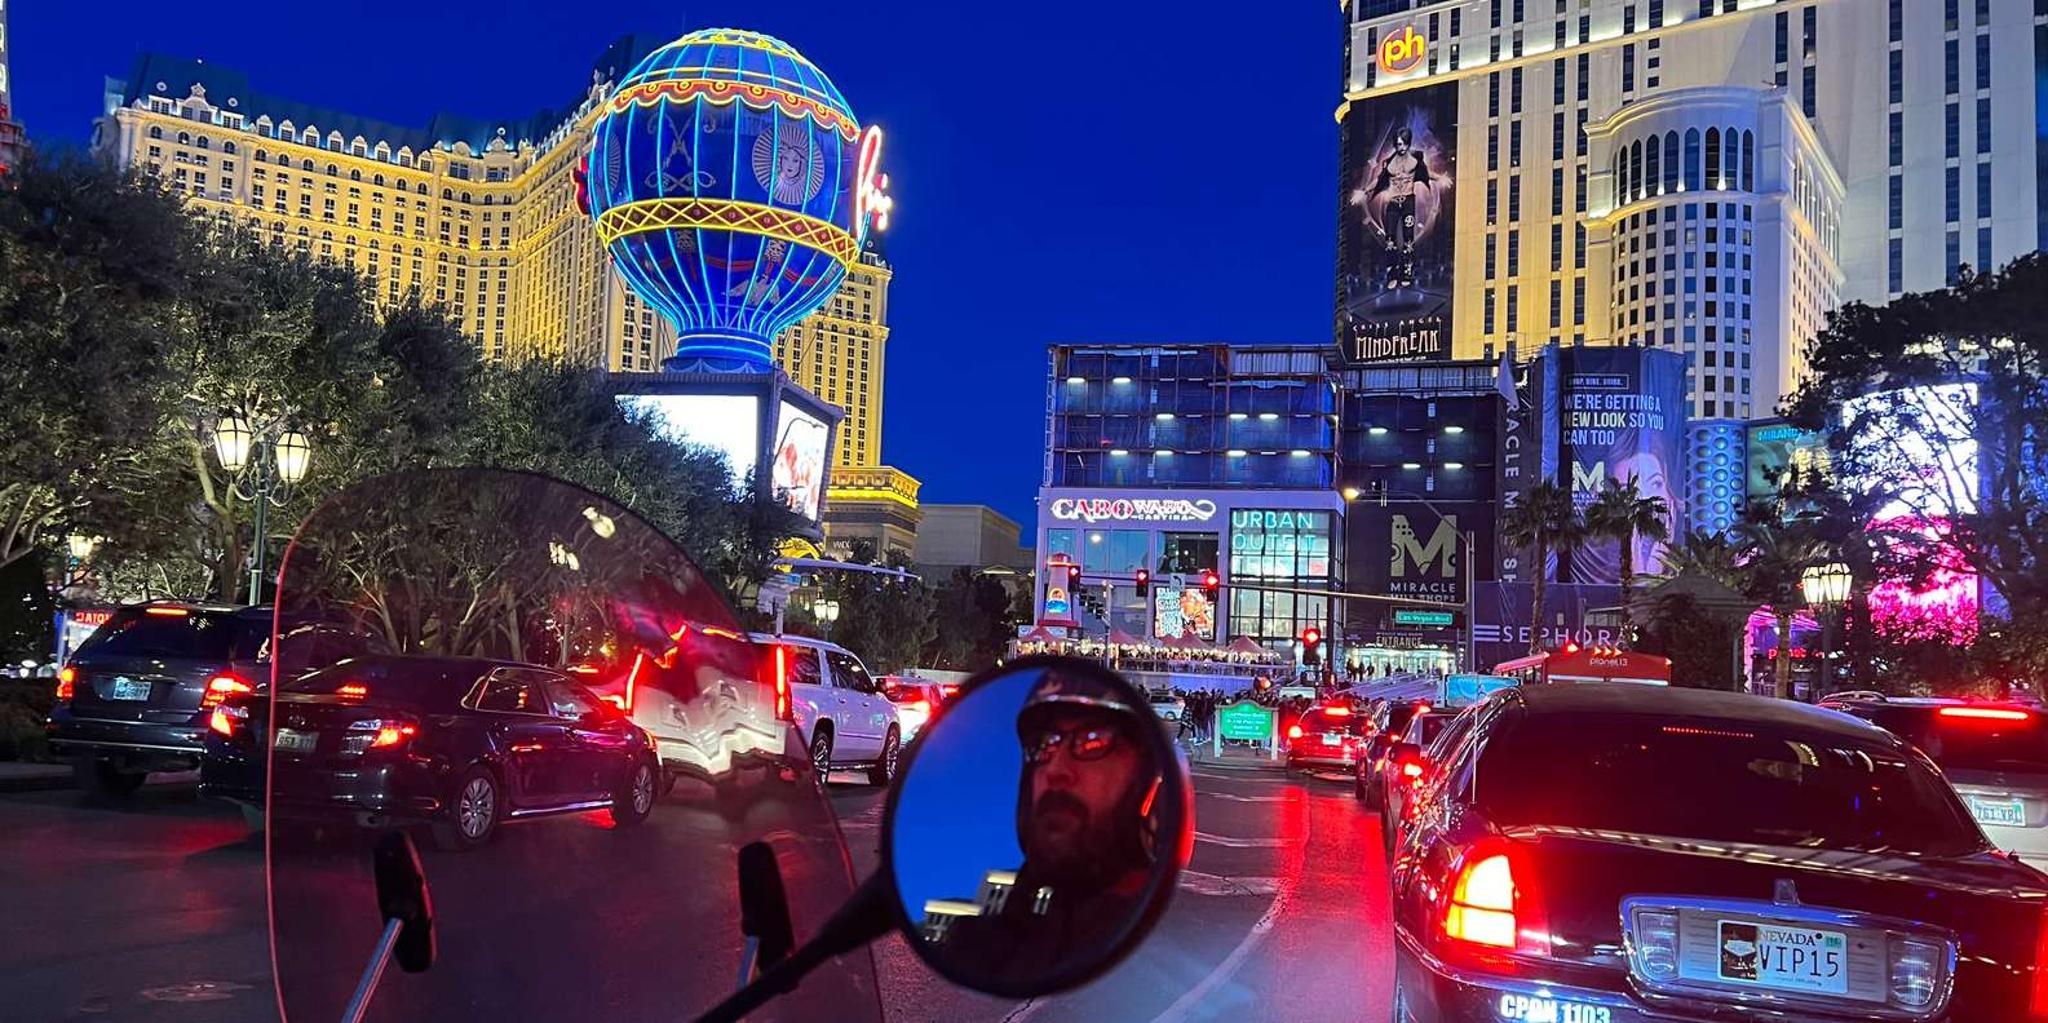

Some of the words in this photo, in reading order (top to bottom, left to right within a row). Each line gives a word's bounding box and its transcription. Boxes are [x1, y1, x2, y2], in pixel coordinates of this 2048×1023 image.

[1385, 26, 1424, 67] ph
[1356, 330, 1441, 359] MINDFREAK
[1564, 394, 1602, 410] WE'RE
[1605, 394, 1655, 411] GETTING
[1564, 412, 1591, 427] NEW
[1594, 412, 1626, 428] LOOK
[1629, 412, 1645, 428] SO
[1648, 413, 1664, 430] YOU
[1505, 402, 1520, 478] RACLE
[1564, 430, 1588, 445] CAN
[1591, 430, 1615, 445] TOO
[1051, 499, 1134, 523] CABO
[1133, 499, 1217, 520] WABO
[1233, 511, 1312, 528] URBAN
[1391, 582, 1456, 593] MIRACLE
[1413, 615, 1433, 623] Vegas
[1376, 637, 1423, 649] ENTRANCE
[1761, 930, 1816, 947] NEVADA
[1760, 944, 1839, 978] VIP15
[1561, 1002, 1611, 1023] 1103
